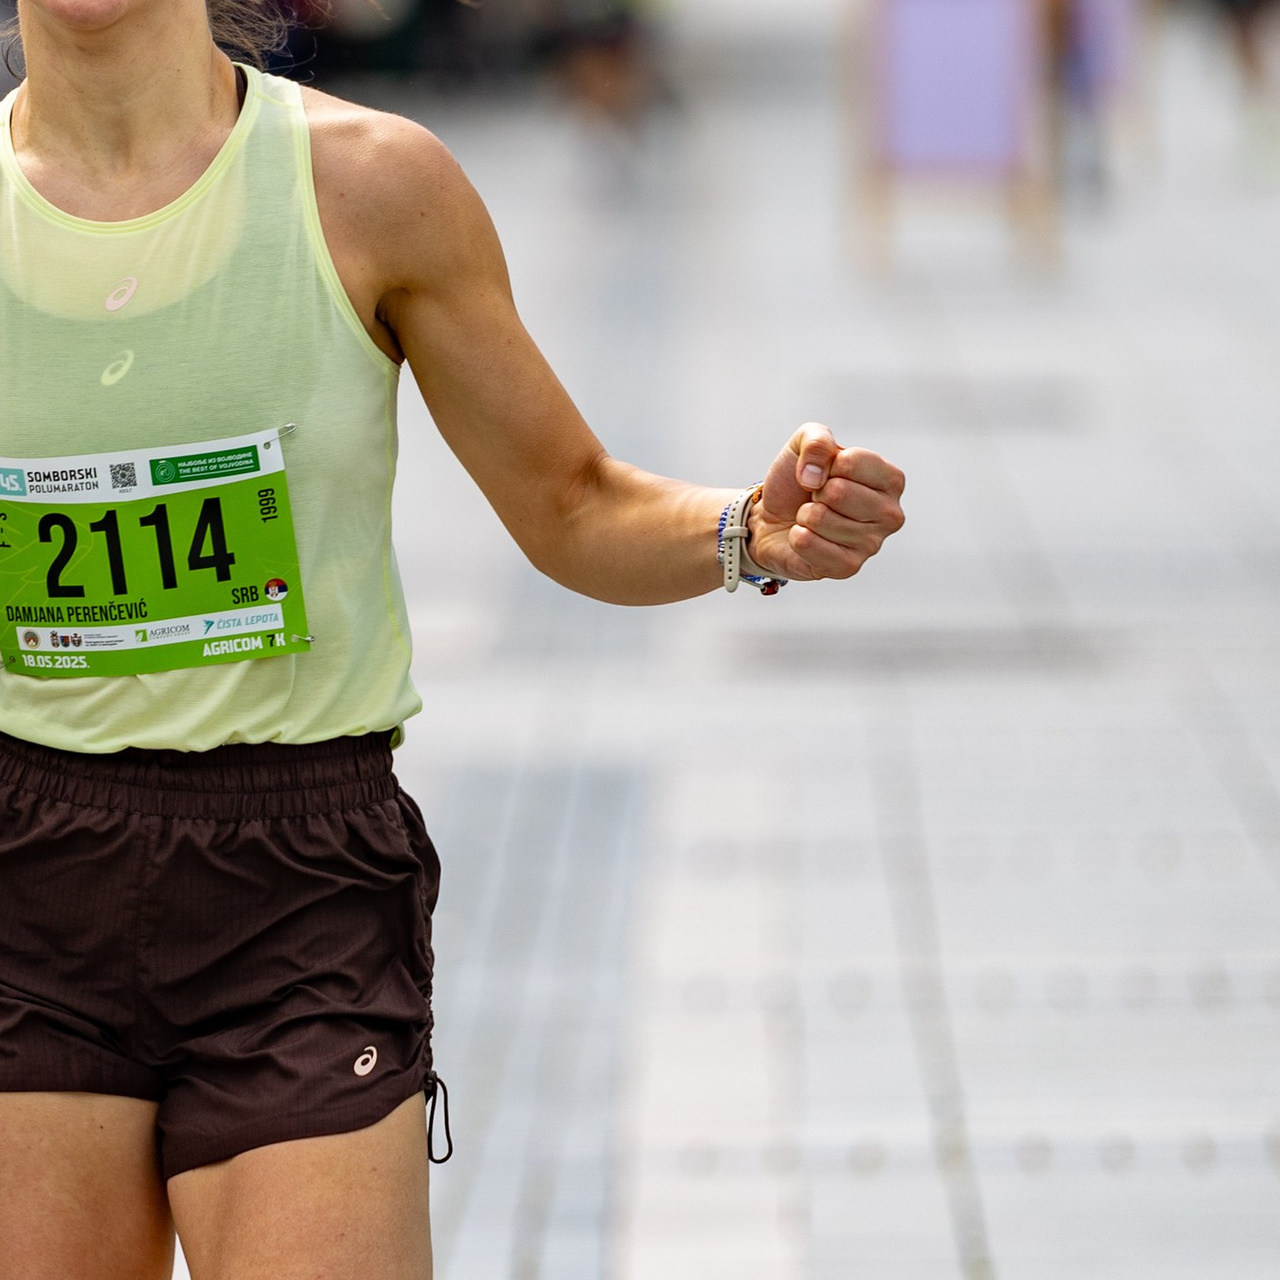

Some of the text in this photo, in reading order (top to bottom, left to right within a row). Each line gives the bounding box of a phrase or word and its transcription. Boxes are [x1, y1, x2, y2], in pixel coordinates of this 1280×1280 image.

[192, 465, 208, 473] BEST
[219, 459, 253, 468] VOJVODINA
[27, 467, 97, 482] SOMBORSKI
[29, 480, 99, 494] POLUMARATON
[258, 488, 278, 523] 1999
[38, 497, 235, 598] 2114
[231, 585, 259, 605] SRB
[6, 598, 148, 623] DAMJANA PERENČEVIĆ
[246, 613, 279, 626] LEPOTA
[150, 624, 190, 636] AGRICOM
[203, 636, 263, 657] AGRICOM
[266, 633, 286, 647] 7K
[22, 654, 90, 669] 18.05.2025.
